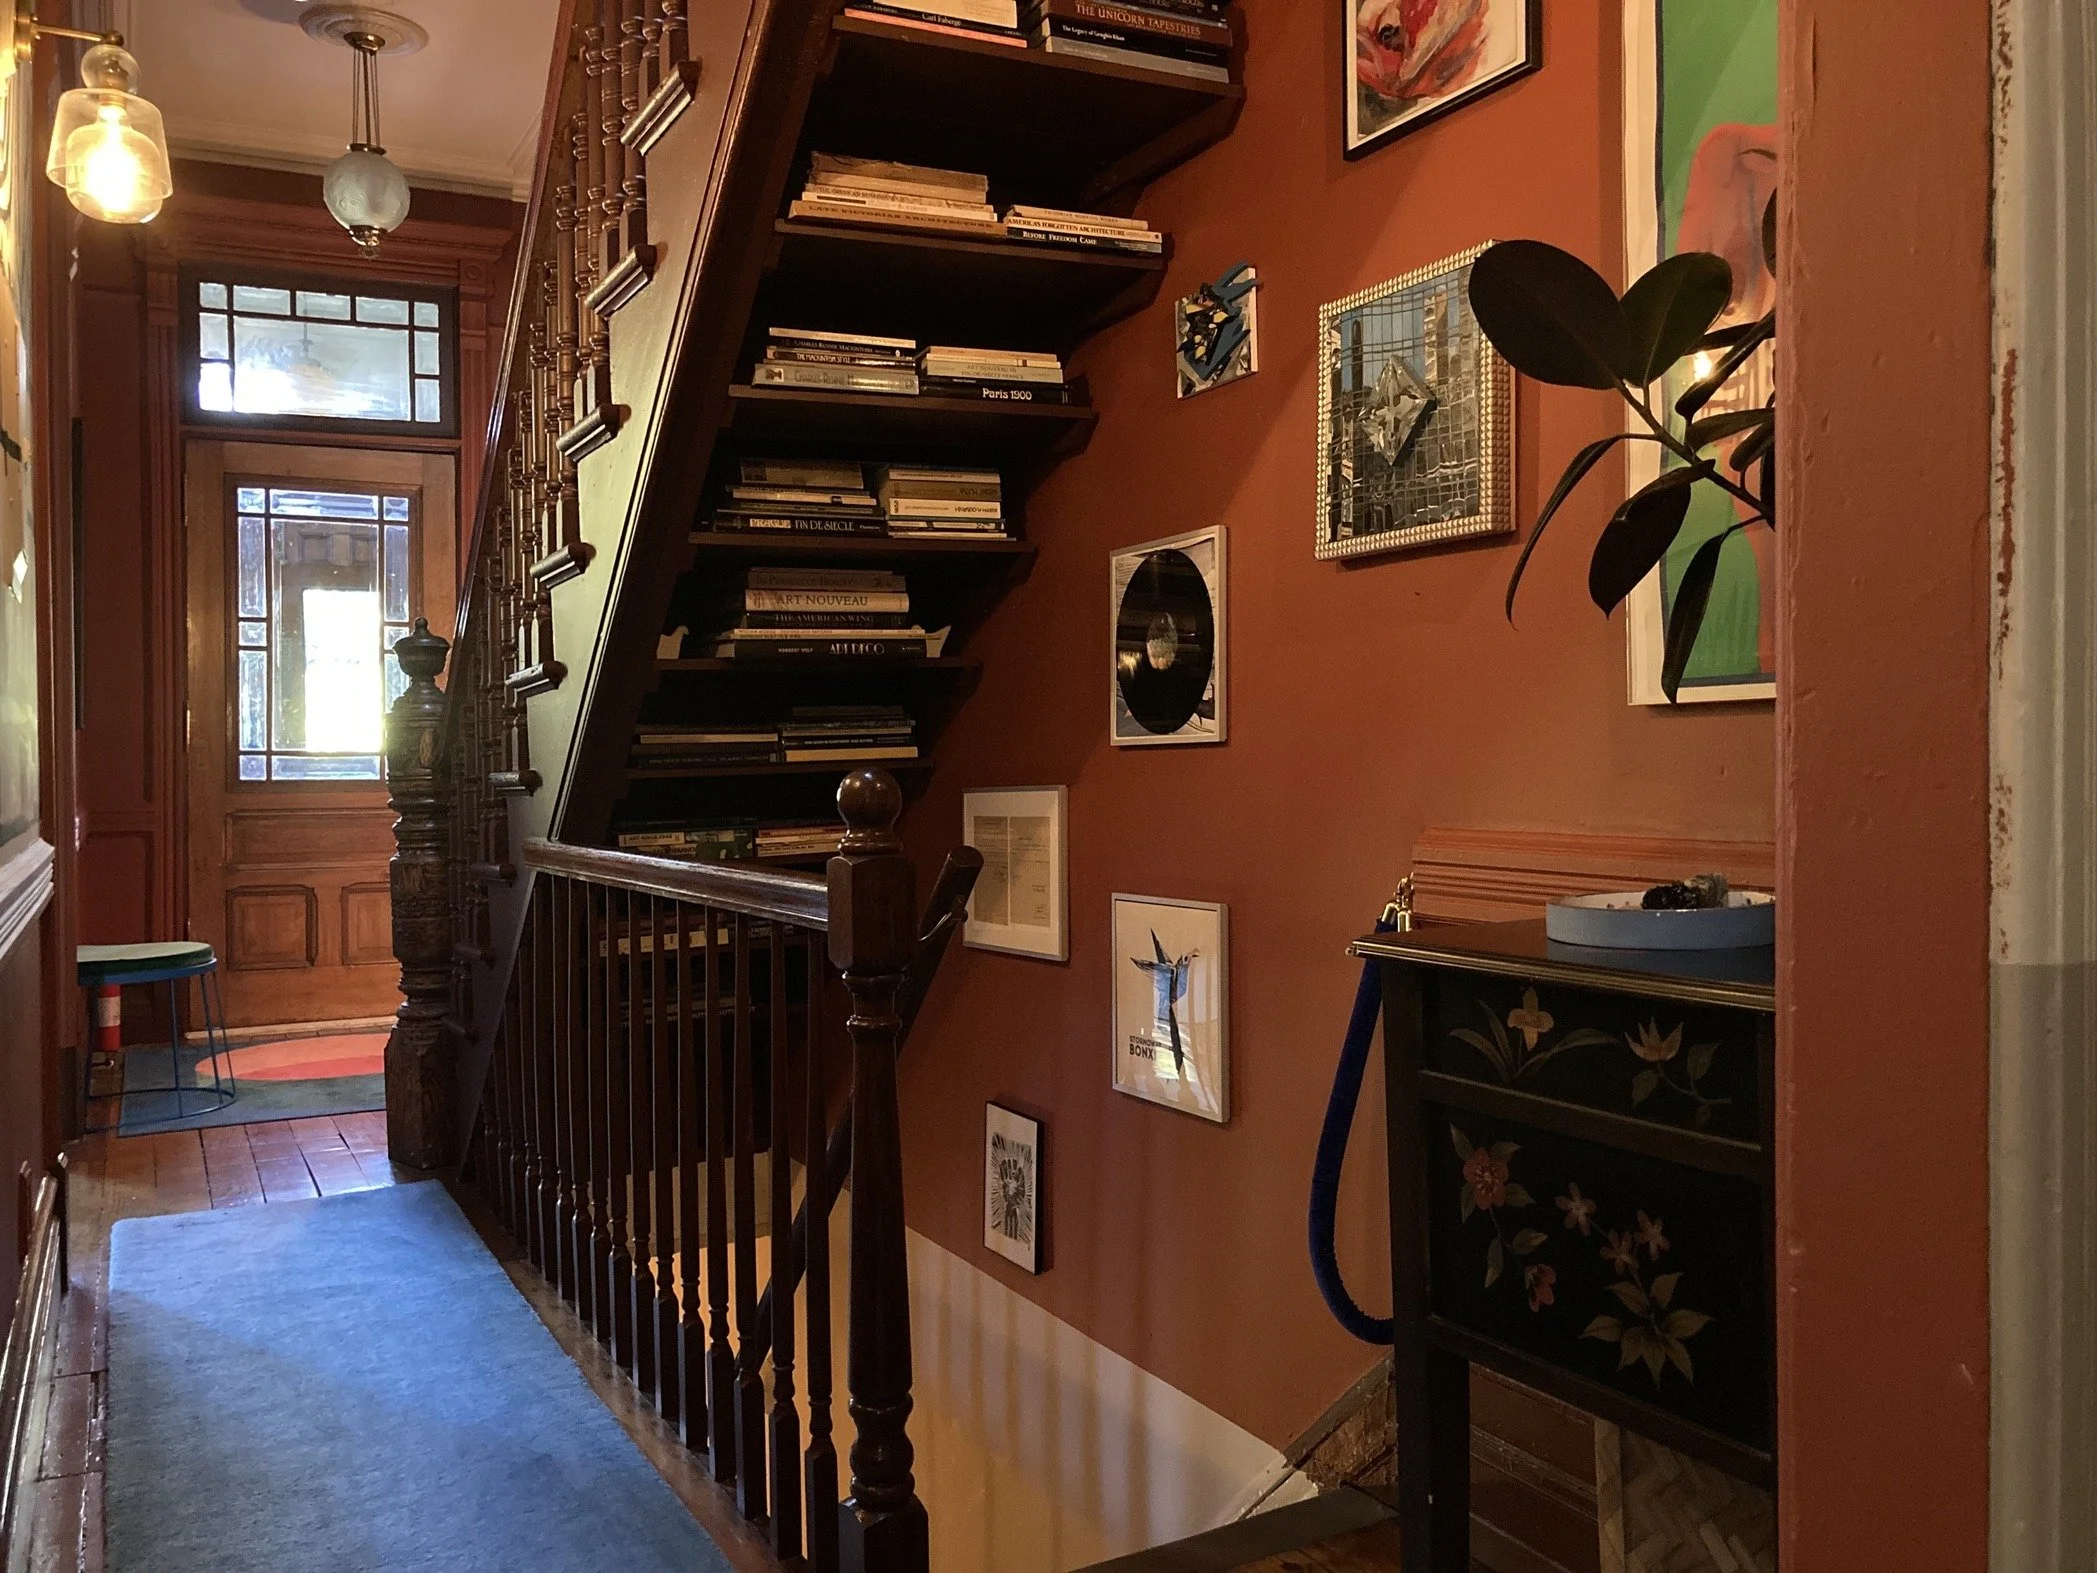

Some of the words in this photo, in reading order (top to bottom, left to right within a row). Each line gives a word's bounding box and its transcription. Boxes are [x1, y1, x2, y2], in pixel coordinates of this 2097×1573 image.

[922, 13, 937, 22] Carl
[1076, 4, 1095, 17] THE
[1098, 8, 1145, 25] UNICORN
[1146, 17, 1202, 36] TAPESTRIES
[841, 208, 901, 219] VICTORIAN
[905, 215, 994, 228] ARCHITECTURE
[1042, 221, 1078, 231] FORGOTTEN
[1079, 226, 1125, 236] ARCHITECTURE
[1022, 230, 1046, 240] BEFORE
[1048, 233, 1077, 243] FREEDOM
[1079, 236, 1098, 245] CAME
[982, 387, 1009, 399] Paris
[1010, 390, 1032, 401] 1900
[751, 519, 790, 528] PRAGUE
[795, 520, 808, 530] FIN
[810, 520, 823, 530] DE
[776, 595, 802, 605] ART
[805, 595, 868, 606] NOUVEAU
[775, 613, 796, 622] THE
[797, 613, 846, 622] AMERICAN
[848, 614, 873, 622] WING
[829, 643, 849, 655] ART
[851, 643, 885, 655] DECO
